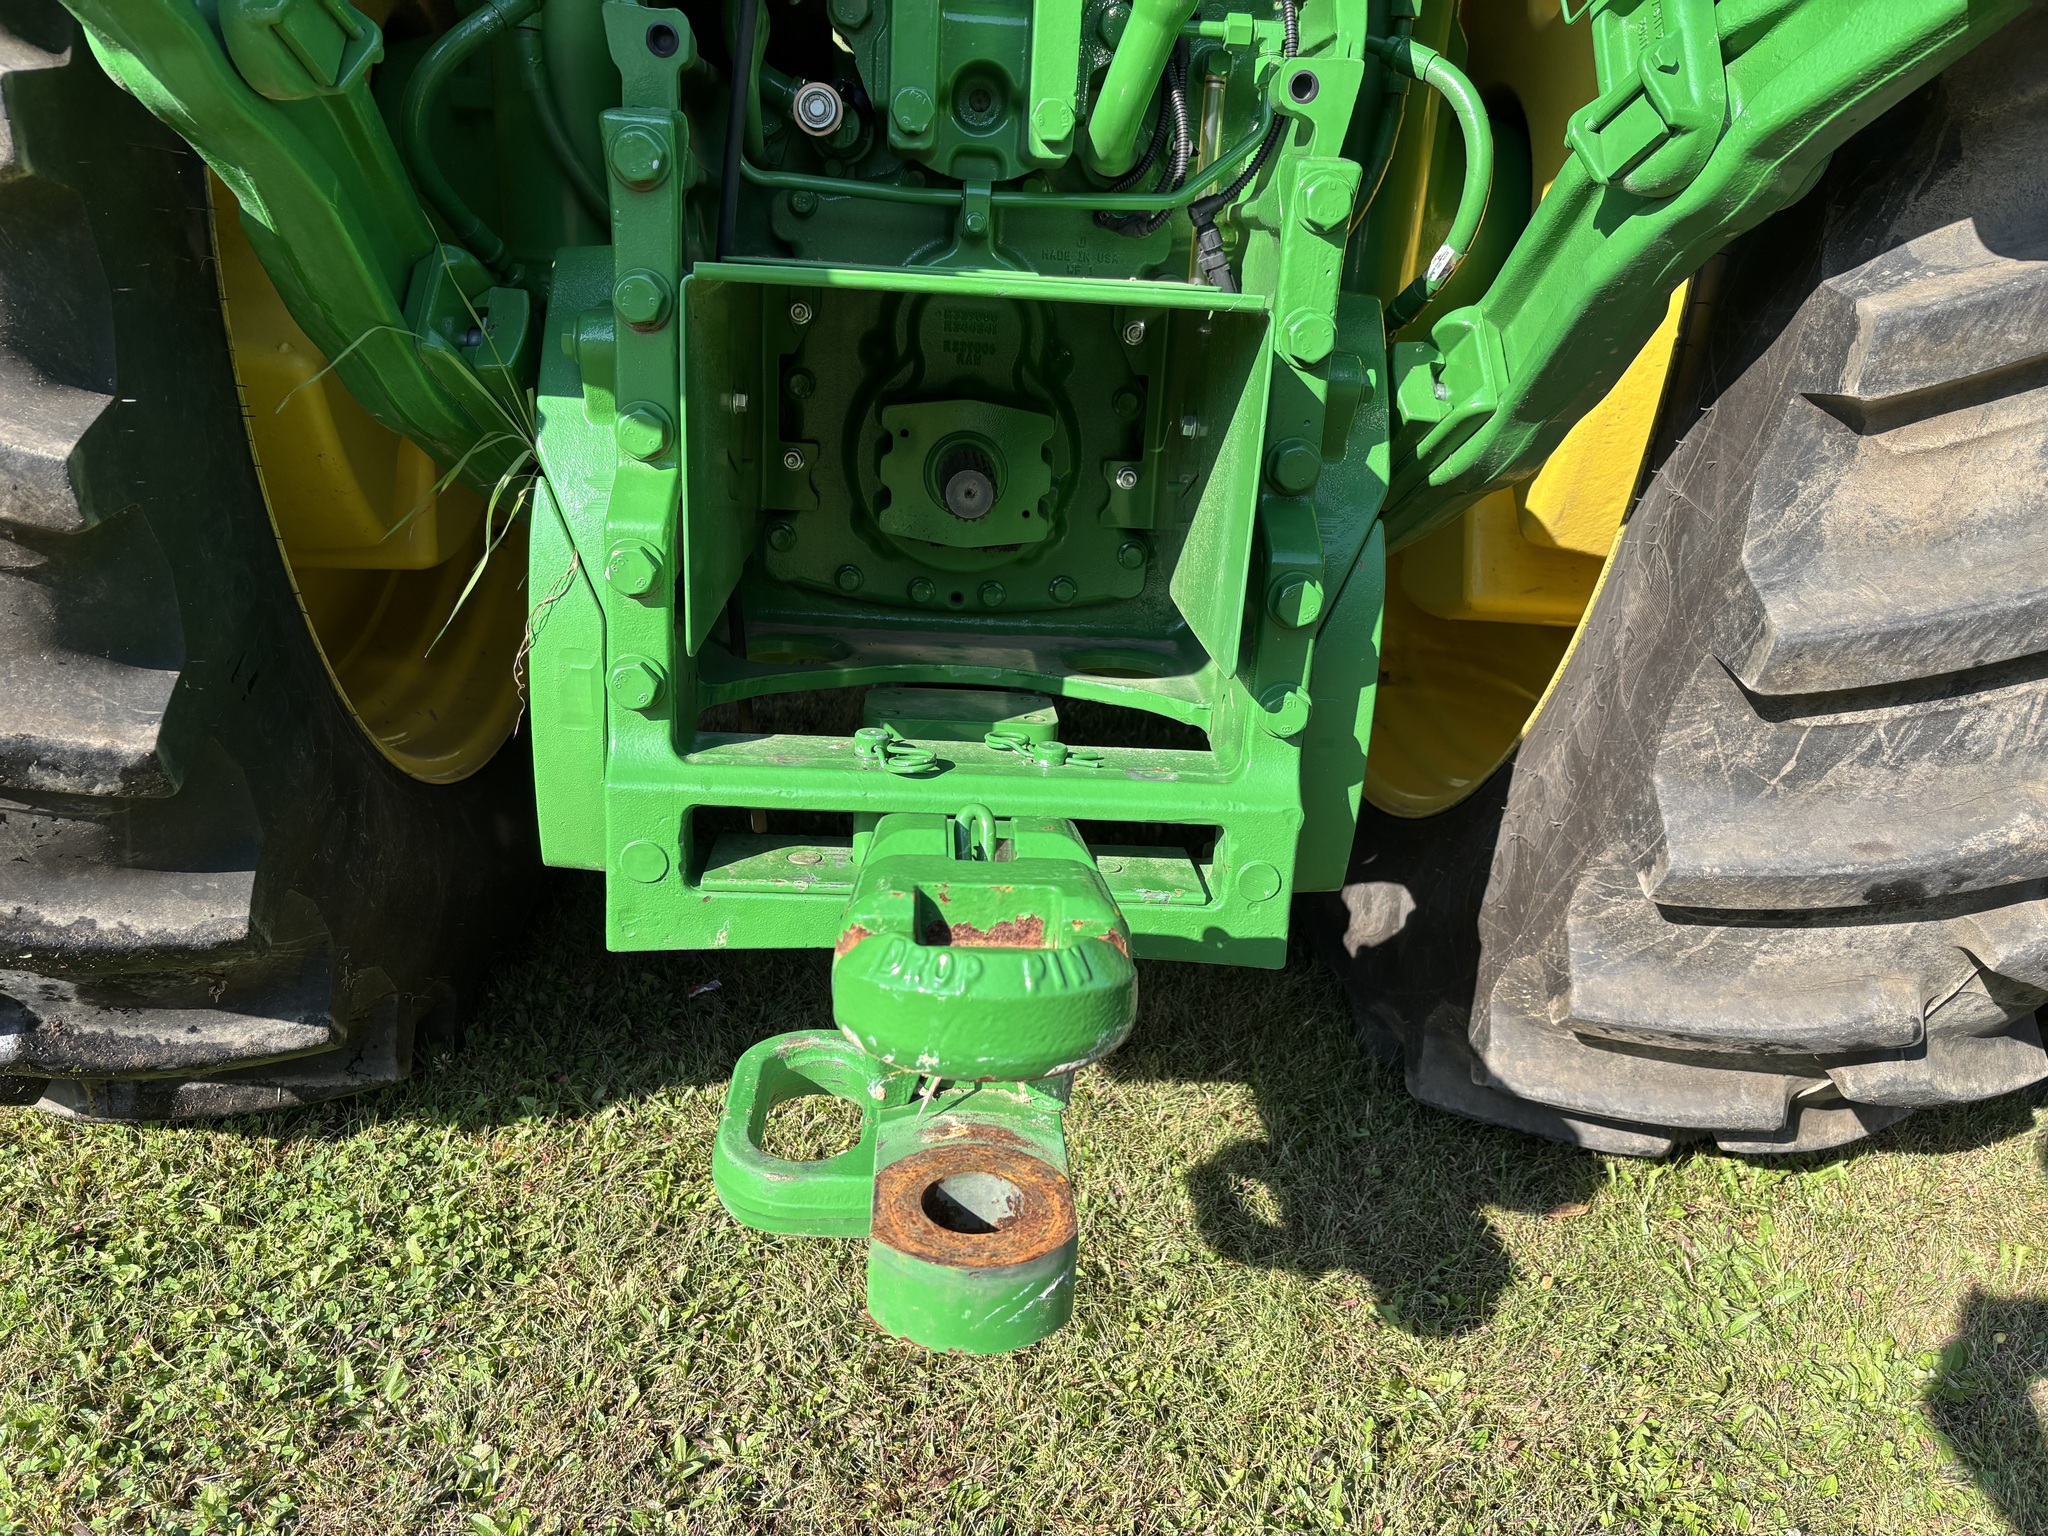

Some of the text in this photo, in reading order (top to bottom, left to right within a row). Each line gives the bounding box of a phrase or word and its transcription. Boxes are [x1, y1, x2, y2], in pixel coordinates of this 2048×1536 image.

[1041, 248, 1118, 265] MADE IN USA
[873, 937, 1093, 997] DROP PIN
